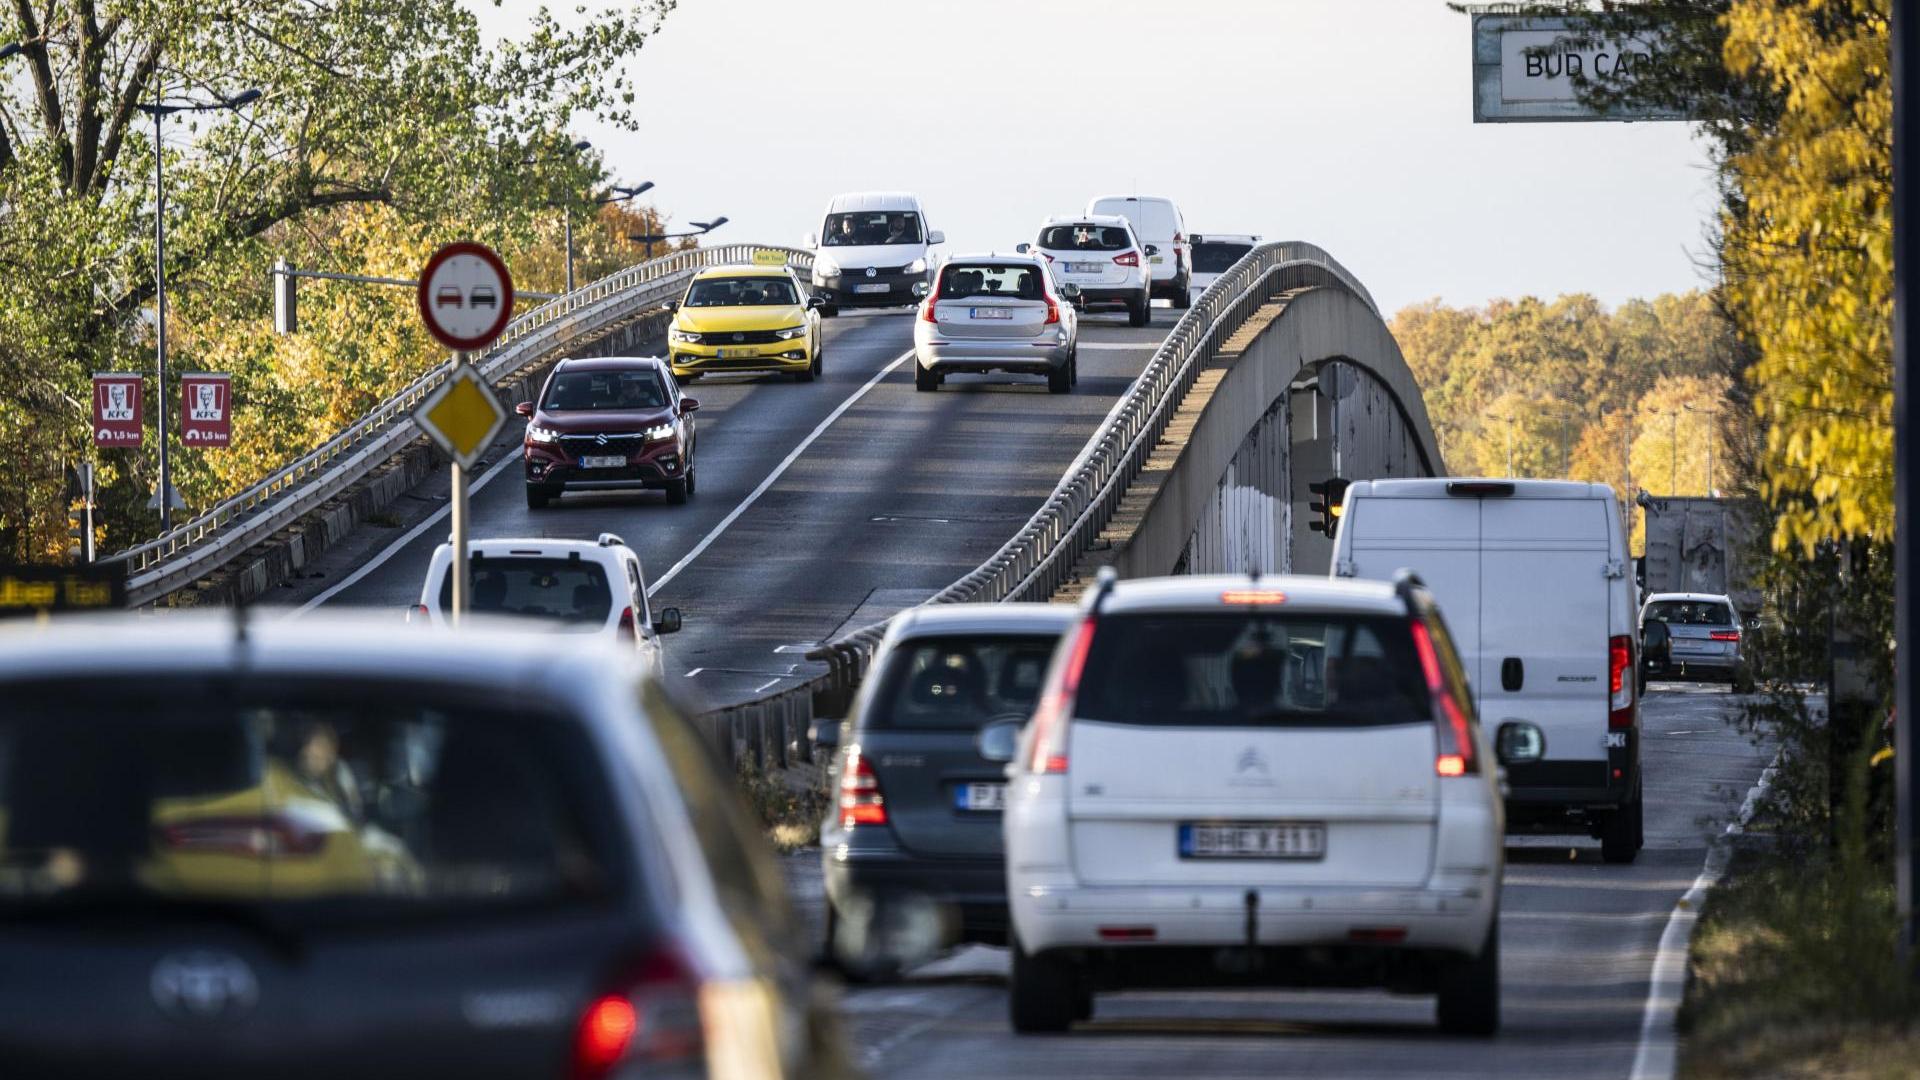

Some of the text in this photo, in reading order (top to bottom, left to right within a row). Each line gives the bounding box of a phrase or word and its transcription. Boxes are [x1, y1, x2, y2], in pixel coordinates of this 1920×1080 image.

[1526, 53, 1583, 78] BUD
[107, 410, 129, 419] KFC
[195, 411, 218, 419] KFC
[127, 431, 139, 440] km
[214, 431, 227, 440] km
